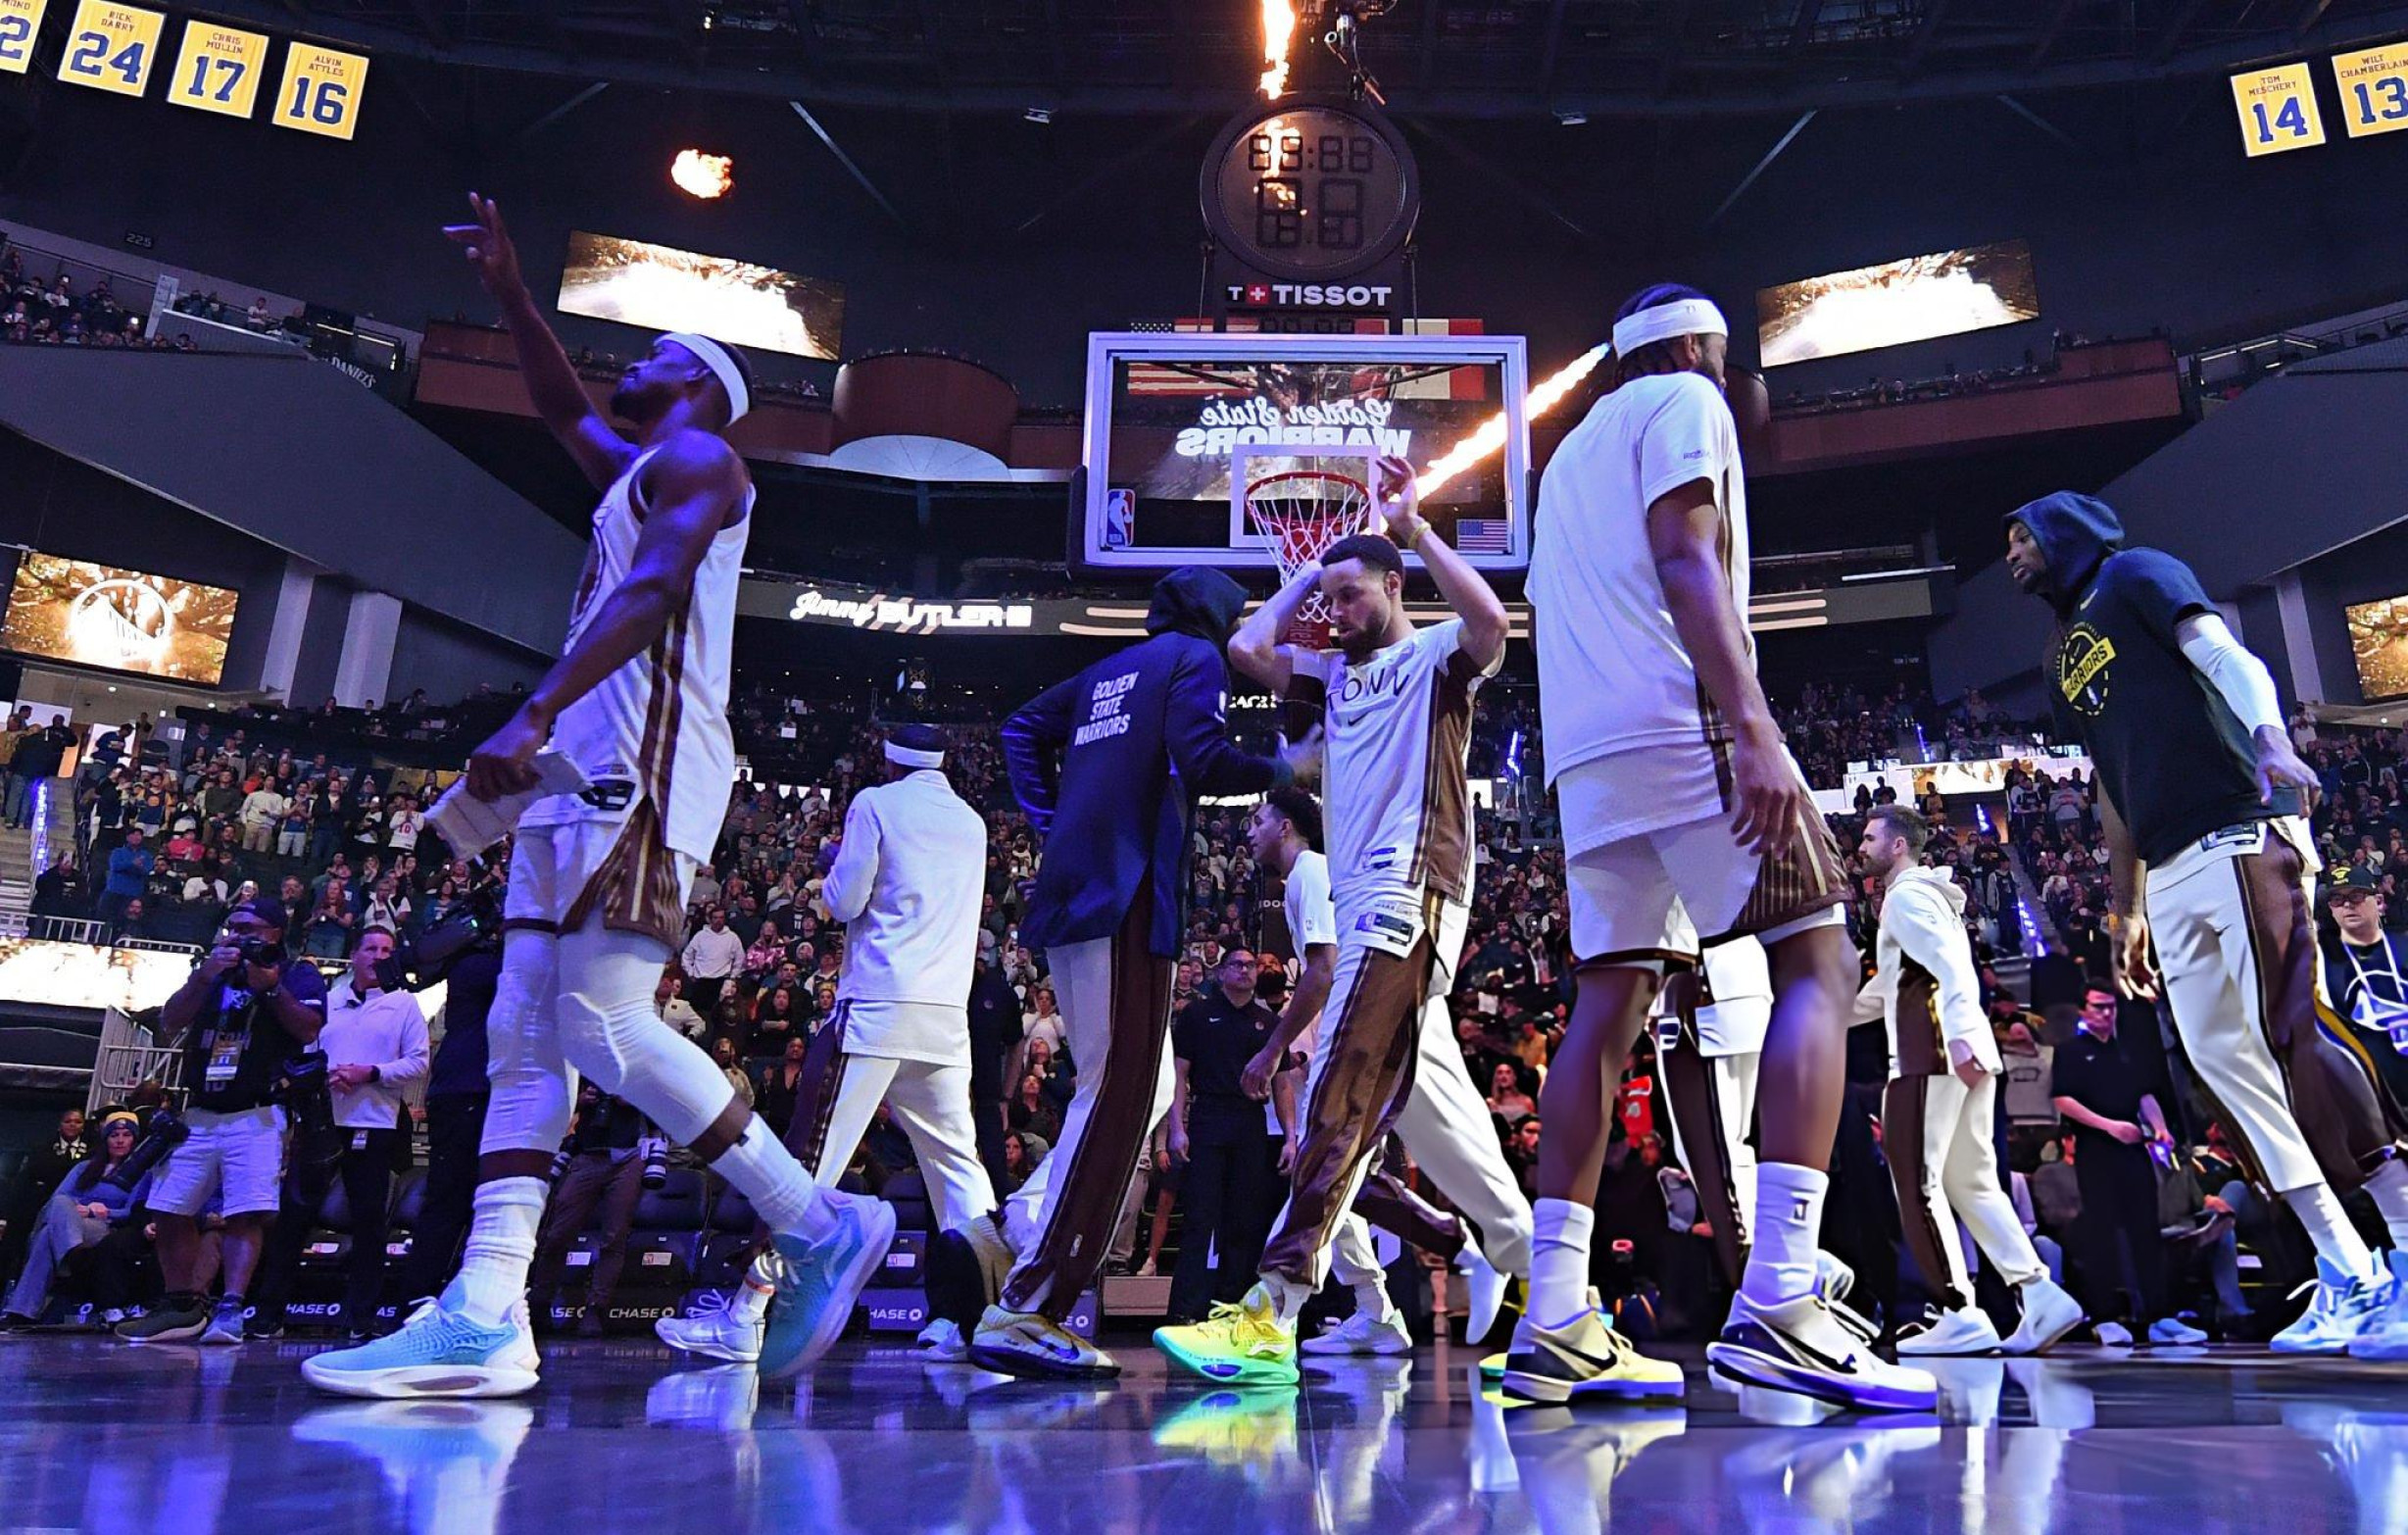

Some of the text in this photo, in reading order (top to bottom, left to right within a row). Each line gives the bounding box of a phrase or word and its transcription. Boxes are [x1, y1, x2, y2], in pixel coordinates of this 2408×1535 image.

[109, 11, 133, 23] RICK
[0, 16, 31, 60] 2
[206, 40, 244, 54] MULLIN
[212, 32, 241, 45] CHRIS
[71, 31, 145, 83] 24
[314, 55, 343, 67] ALVIN
[2361, 54, 2384, 64] WILT
[188, 56, 246, 102] 17
[308, 63, 344, 76] ATTLES
[2248, 80, 2297, 96] MESCHERY
[2260, 75, 2281, 85] TOM
[290, 76, 348, 124] 16
[2354, 76, 2408, 124] 13
[2252, 96, 2308, 142] 14
[1272, 284, 1392, 306] TISSOT
[790, 591, 875, 626] Jimmy
[876, 600, 1003, 627] BUTLER
[1092, 670, 1140, 701] GOLDEN
[1090, 694, 1125, 721] STATE
[1074, 714, 1131, 746] WARRIORS
[285, 1304, 327, 1314] HASE
[609, 1308, 661, 1318] CHASE
[870, 1309, 908, 1319] HASE
